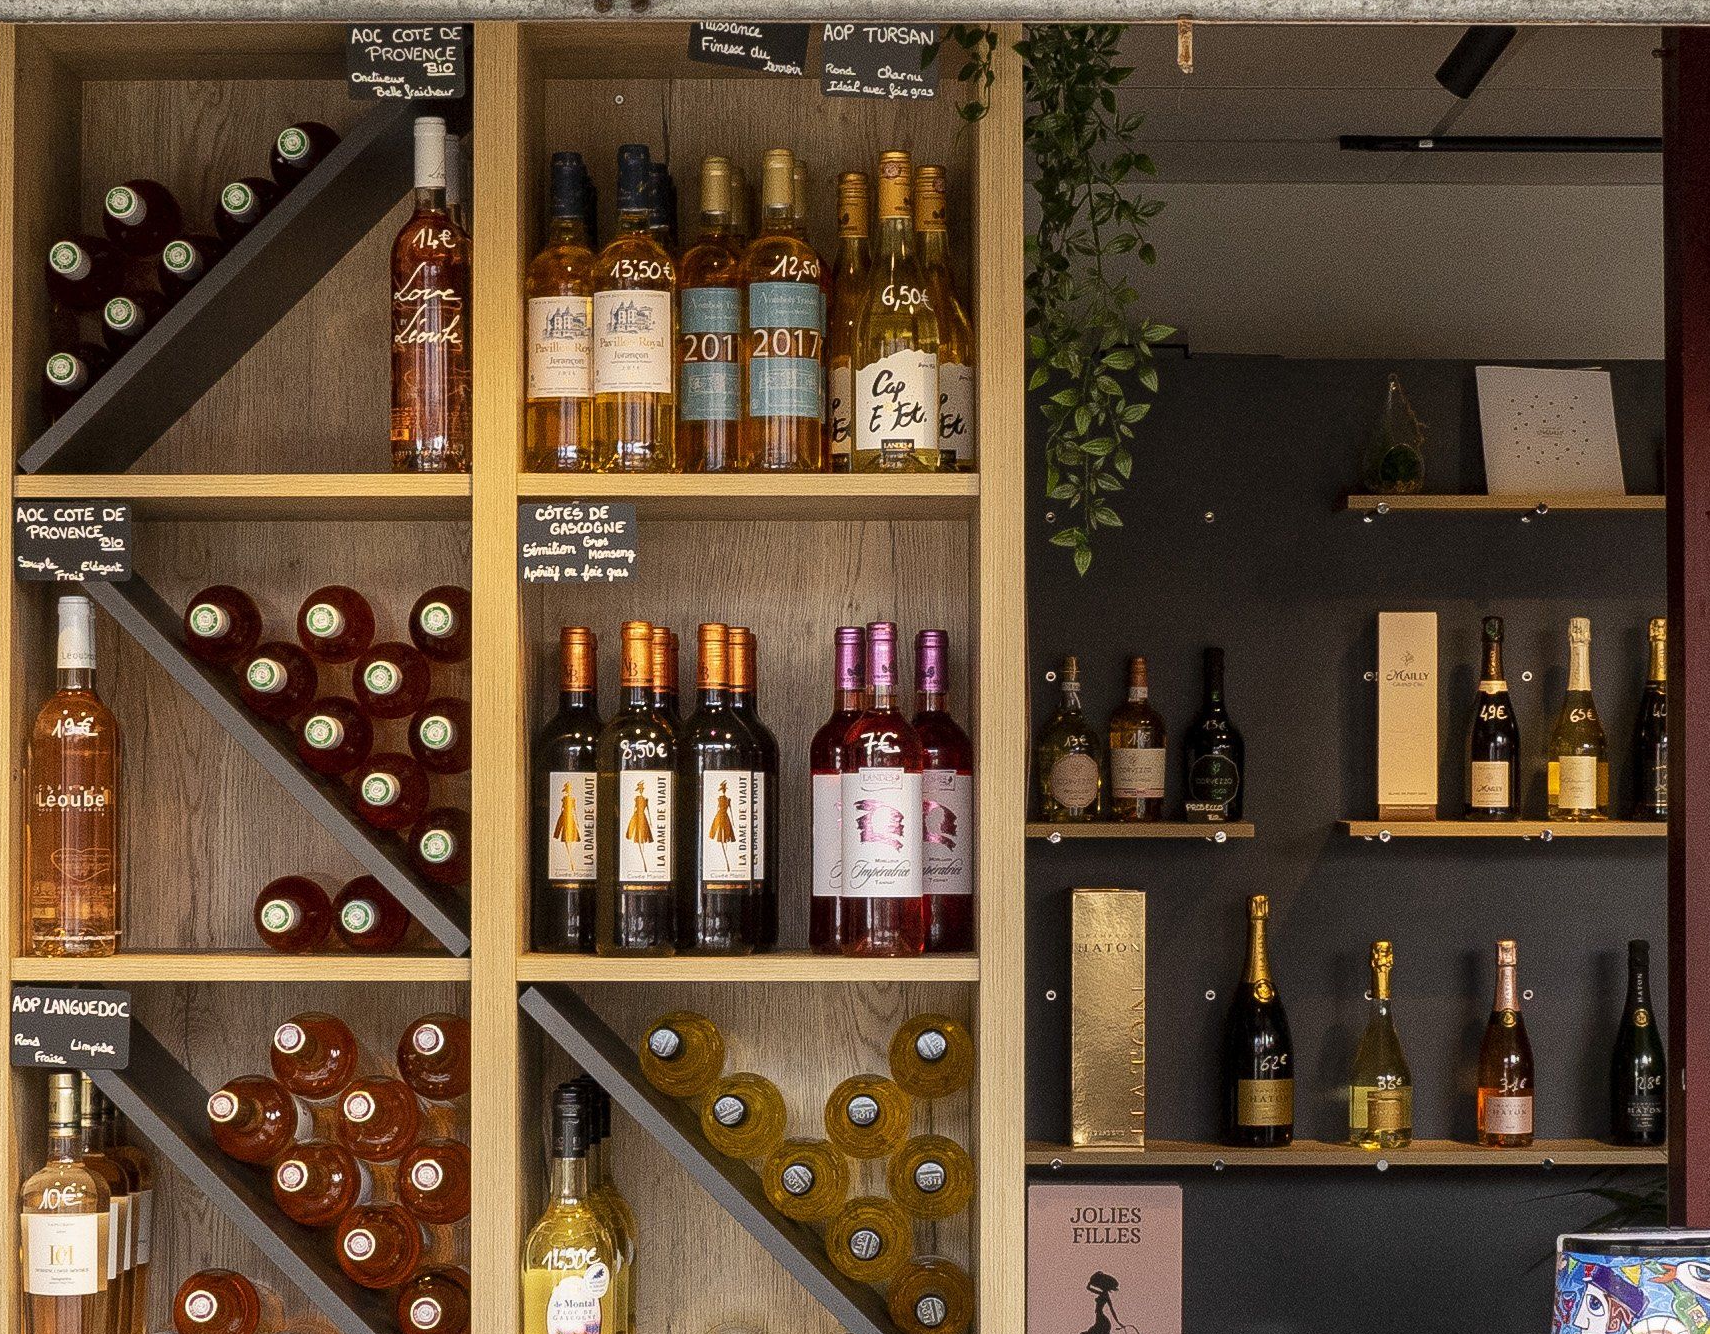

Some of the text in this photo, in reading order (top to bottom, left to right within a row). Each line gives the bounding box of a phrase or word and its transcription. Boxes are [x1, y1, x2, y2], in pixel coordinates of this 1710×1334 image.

[351, 26, 462, 45] AOC COTE DE
[823, 24, 934, 46] AOP TURSAN
[365, 46, 457, 62] PROVENCE
[750, 46, 771, 60] du
[372, 85, 403, 98] Belle
[412, 227, 456, 250] 14€
[394, 262, 461, 302] Love
[881, 284, 934, 312] 6,50€
[752, 328, 821, 358] 2017
[871, 369, 906, 404] Cap
[16, 506, 127, 523] AOC COTE DE
[589, 505, 610, 520] DE
[25, 525, 104, 540] PROVENCE
[549, 521, 627, 536] GASCOGNE
[54, 569, 85, 582] Frais
[1385, 668, 1429, 682] MAILLY
[1479, 704, 1508, 722] 49€
[619, 739, 668, 762] 8,50€
[38, 790, 105, 808] Léoube
[657, 776, 667, 866] LA DAME DE VIAUT
[1077, 942, 1141, 953] HATON
[12, 995, 130, 1018] AOP LANGUEDOC
[14, 1033, 41, 1047] Rond
[1259, 1053, 1289, 1072] 62€
[37, 1185, 84, 1210] 10€
[1070, 1207, 1142, 1224] JOLIES
[1072, 1227, 1142, 1244] FILLES
[564, 1298, 596, 1308] Montal
